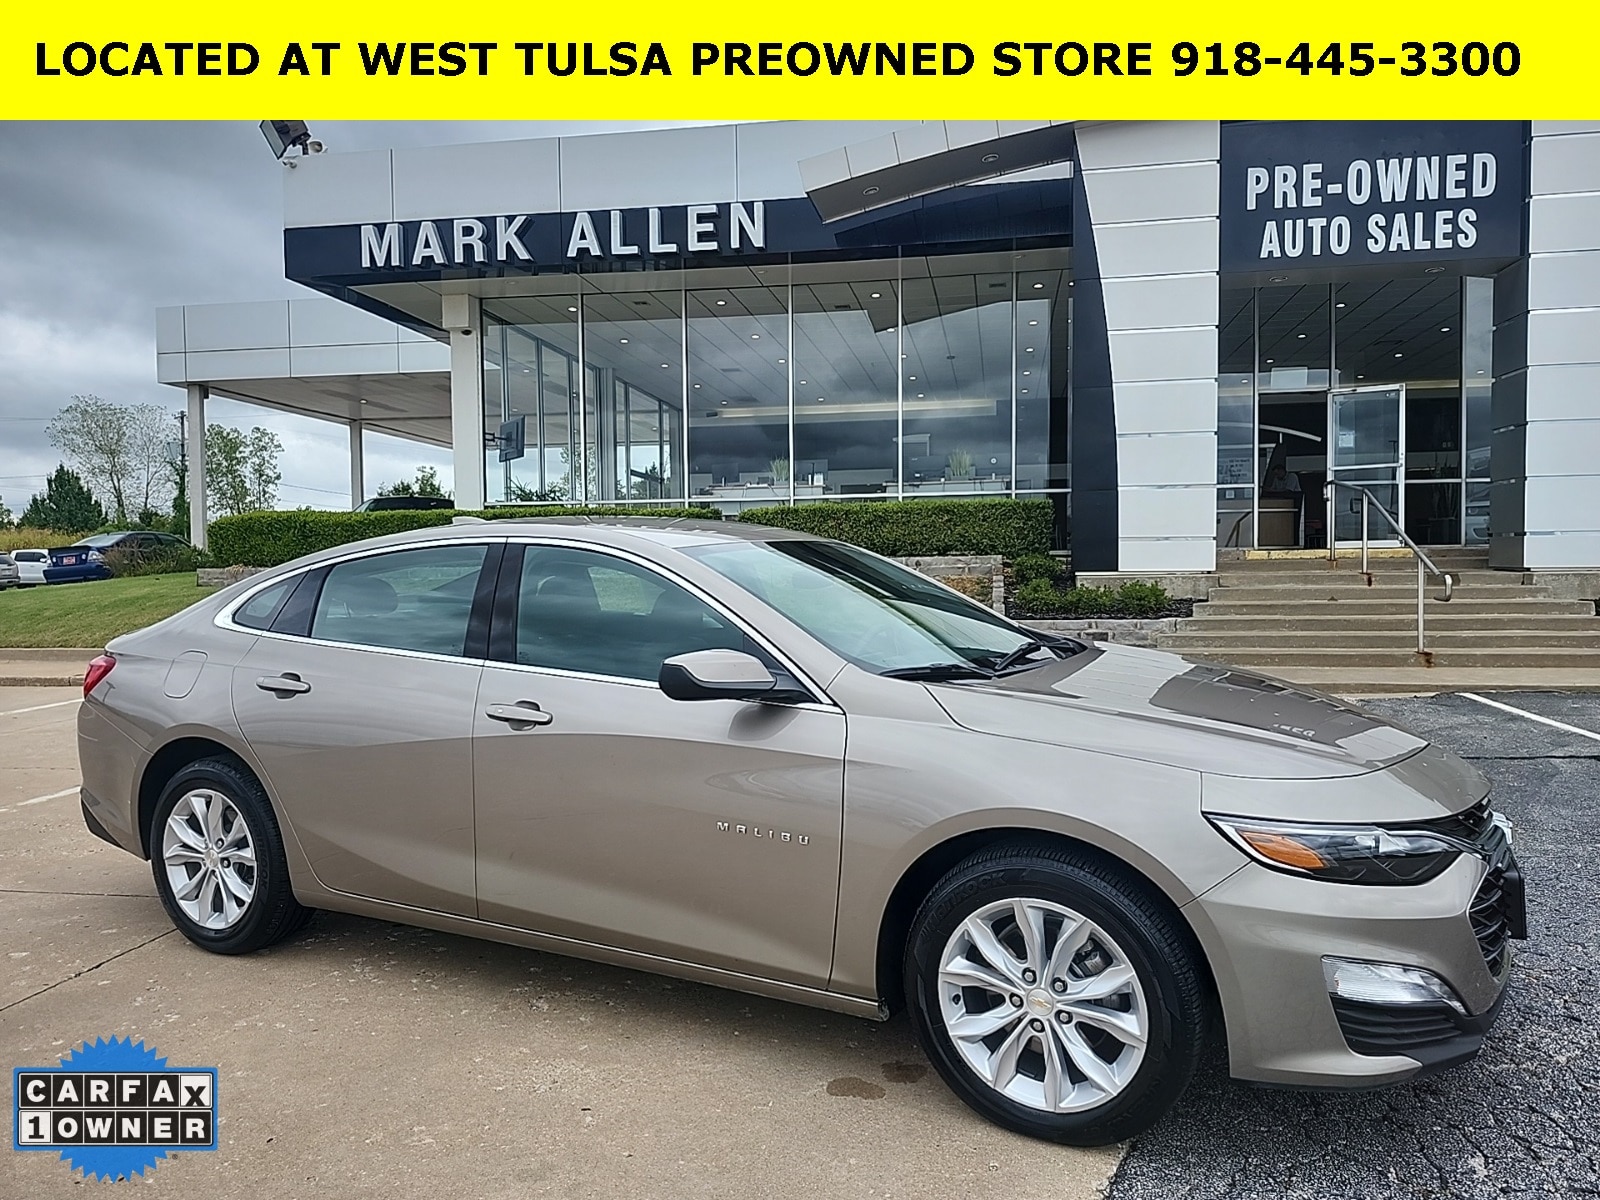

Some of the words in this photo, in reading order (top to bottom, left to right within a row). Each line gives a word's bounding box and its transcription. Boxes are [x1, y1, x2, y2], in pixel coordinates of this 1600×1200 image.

[1246, 152, 1498, 211] PRE-OWNED
[360, 214, 534, 268] MARK
[566, 201, 767, 259] ALLEN
[1259, 215, 1351, 259] AUTO
[1366, 208, 1478, 254] SALES
[716, 821, 809, 845] MALIBU
